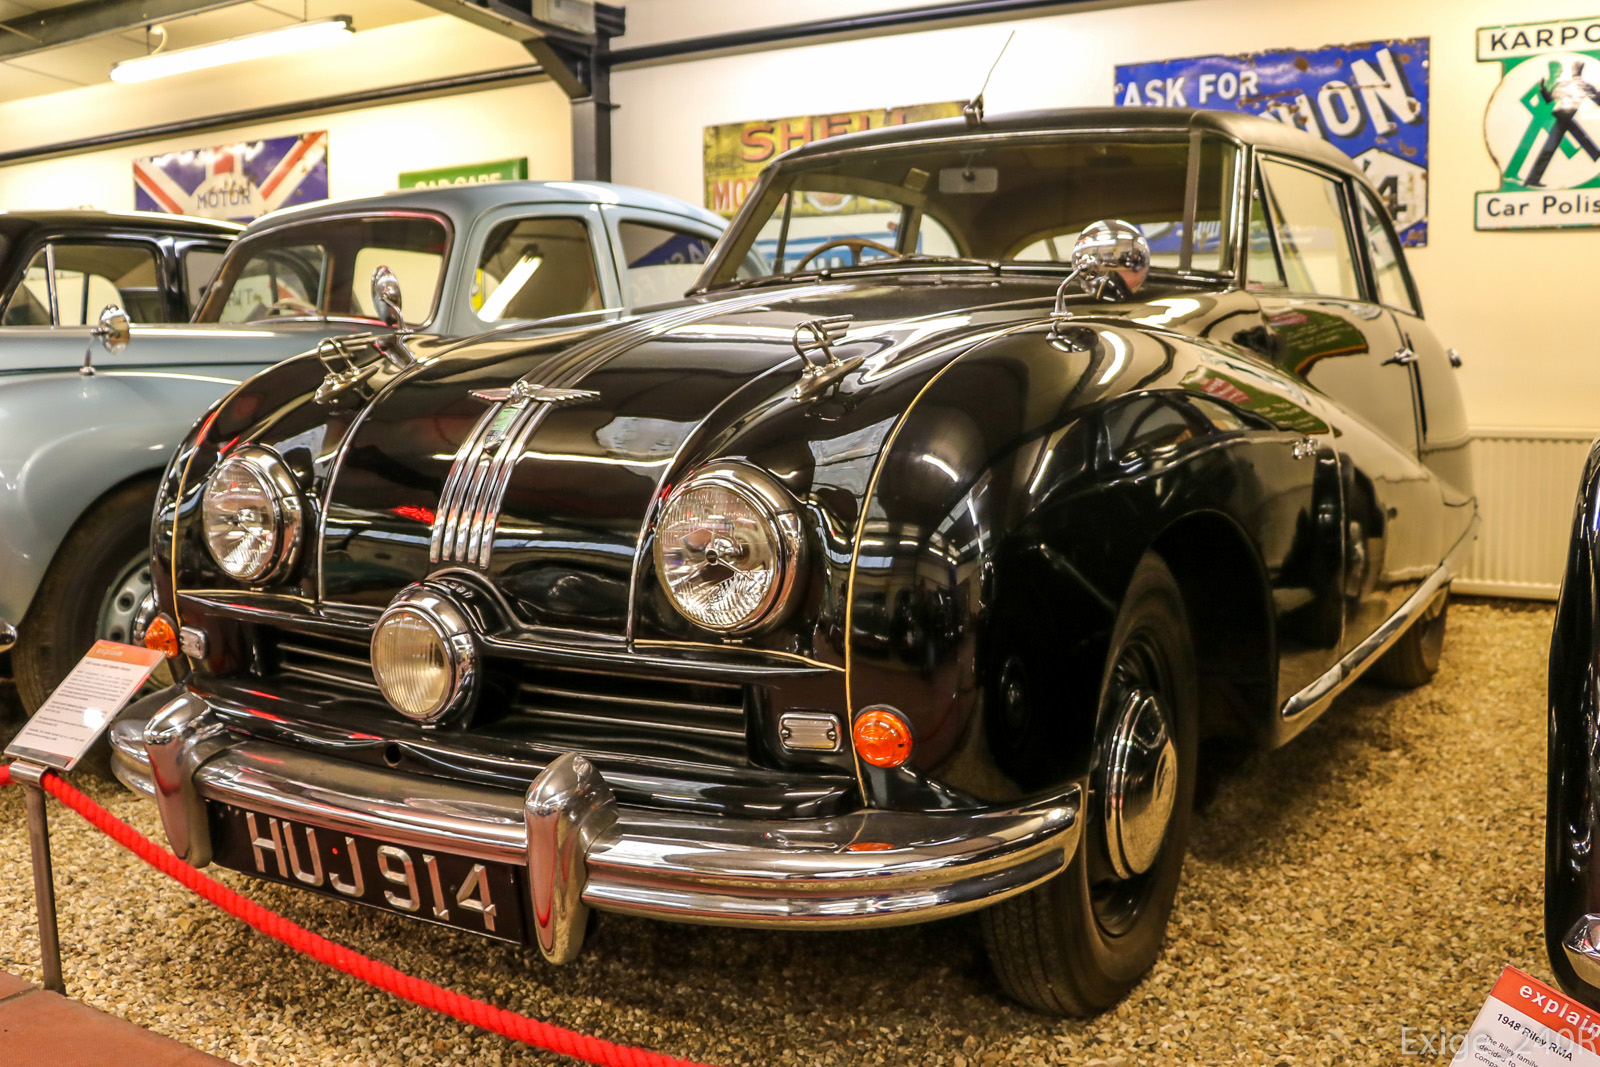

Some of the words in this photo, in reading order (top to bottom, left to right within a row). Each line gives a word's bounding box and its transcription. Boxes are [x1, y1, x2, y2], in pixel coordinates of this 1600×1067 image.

[1122, 77, 1187, 107] ASK
[1199, 71, 1259, 104] FOR
[197, 187, 250, 209] MOTOR
[1487, 198, 1529, 217] Car
[246, 812, 364, 898] HUJ
[377, 845, 497, 932] 914
[1484, 1034, 1498, 1046] The
[1498, 1043, 1514, 1057] Riley
[1497, 1013, 1521, 1032] 1948
[1522, 1027, 1547, 1048] Riley
[1548, 1042, 1573, 1062] RMA
[1479, 1044, 1505, 1062] decided
